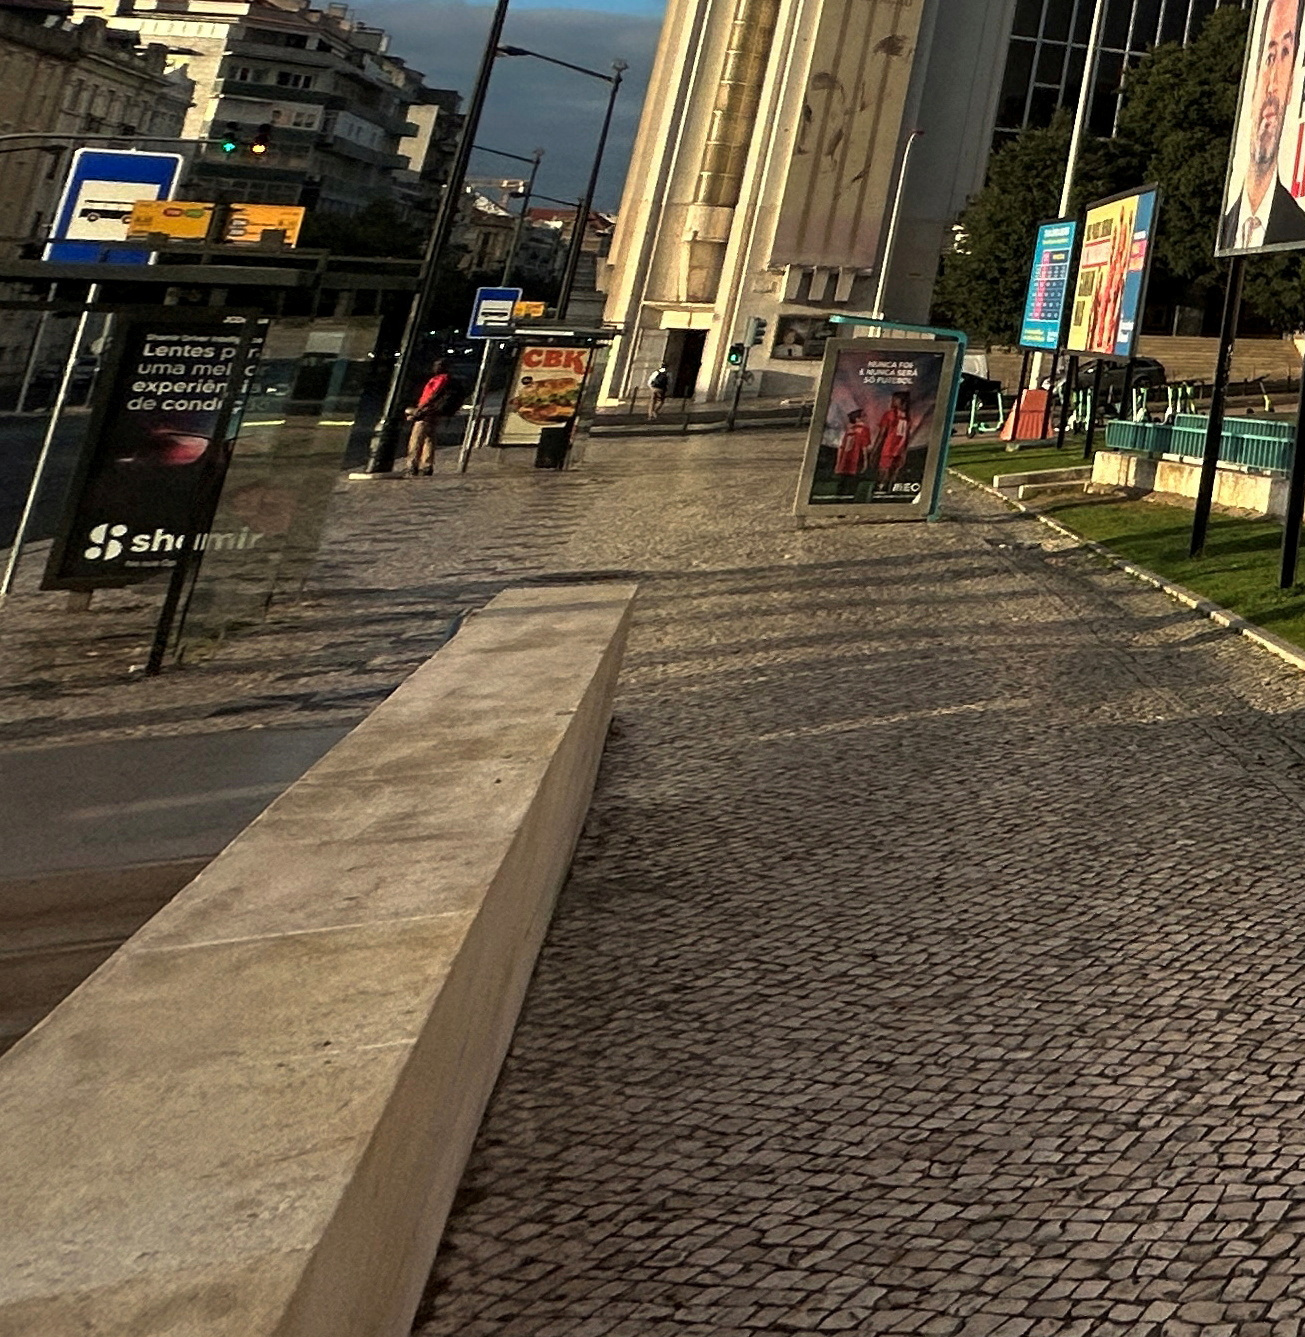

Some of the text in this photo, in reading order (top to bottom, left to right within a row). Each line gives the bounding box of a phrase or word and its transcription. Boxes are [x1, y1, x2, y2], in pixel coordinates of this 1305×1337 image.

[143, 343, 216, 358] Lentes
[137, 363, 186, 375] uma
[127, 395, 157, 411] de
[892, 482, 921, 493] MEO
